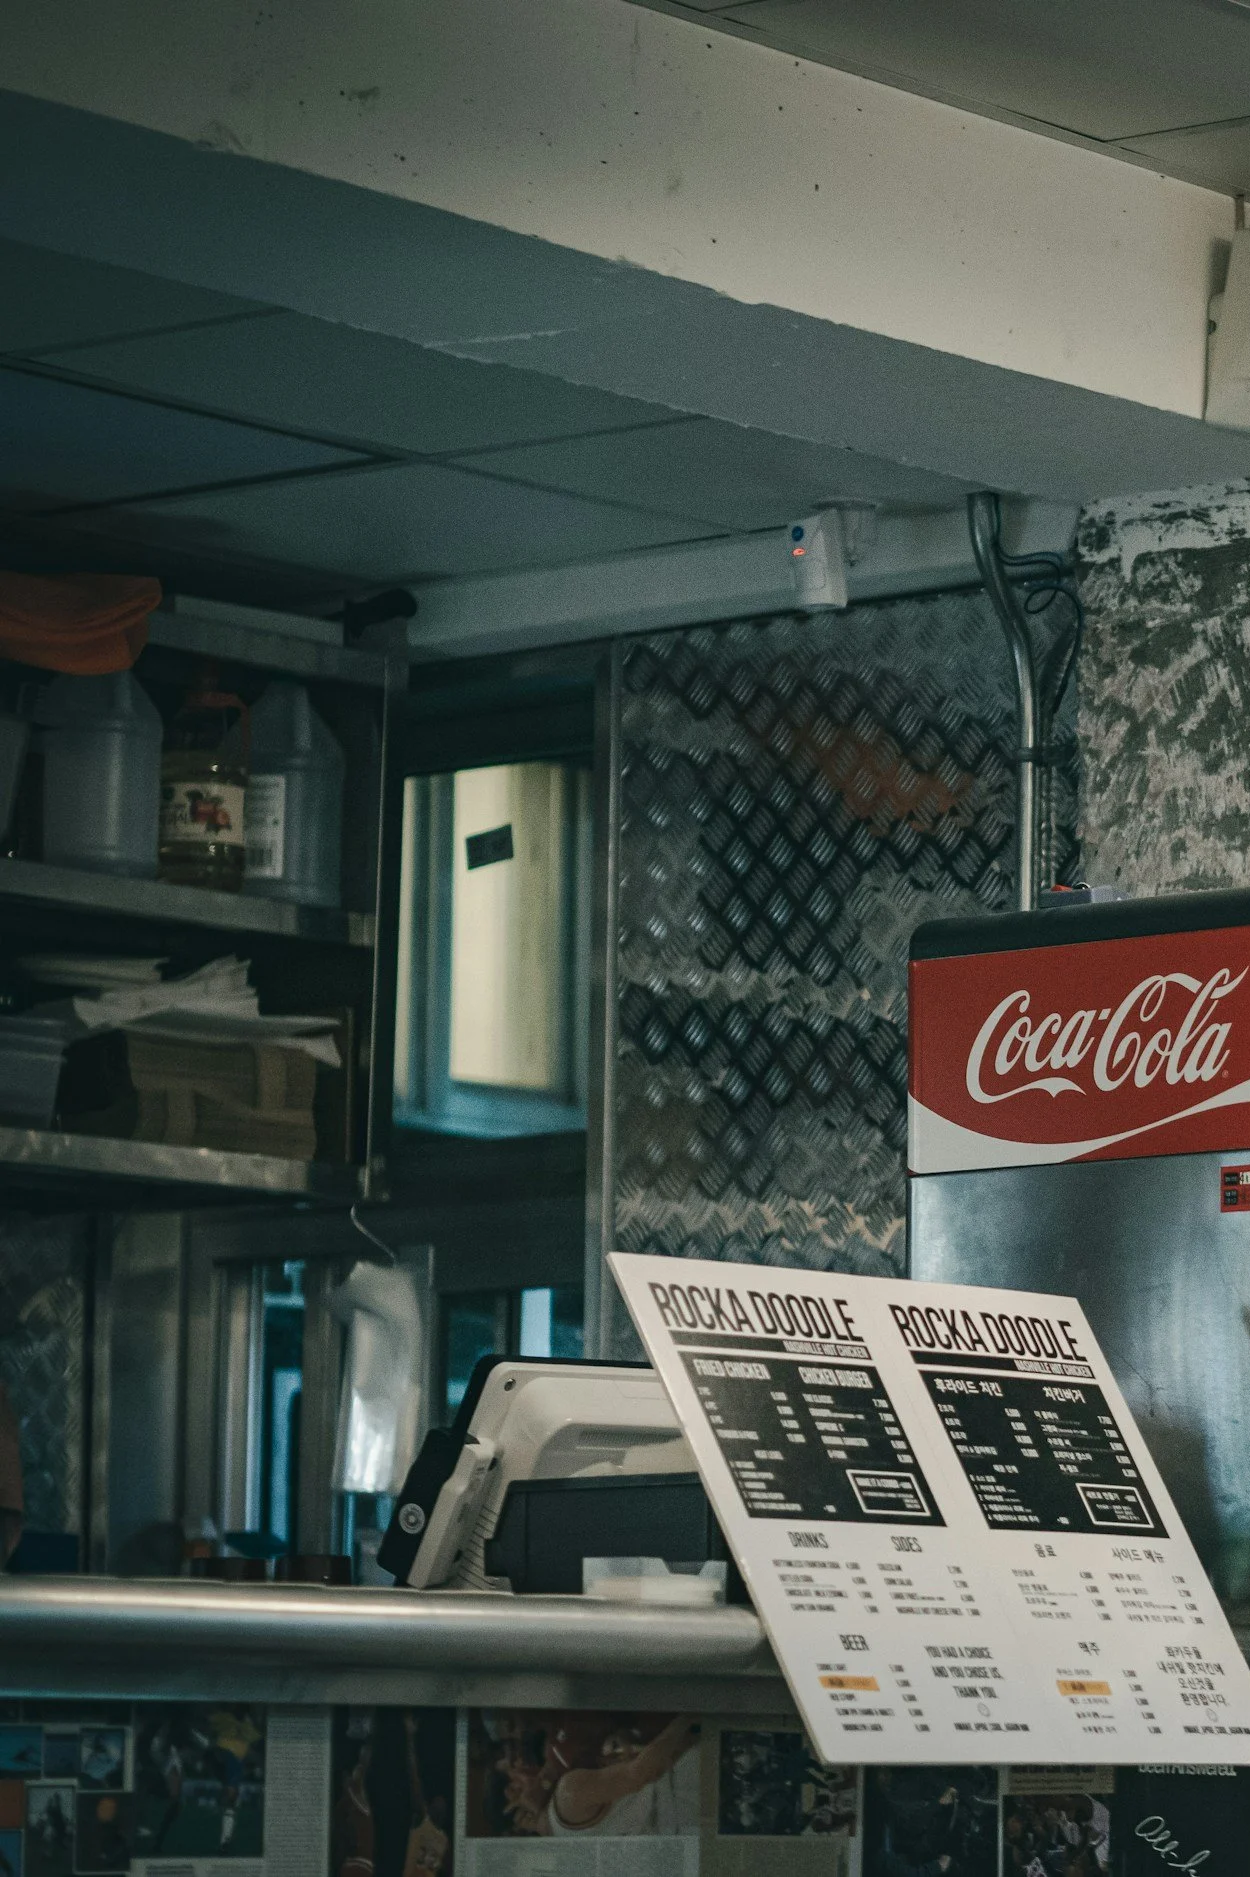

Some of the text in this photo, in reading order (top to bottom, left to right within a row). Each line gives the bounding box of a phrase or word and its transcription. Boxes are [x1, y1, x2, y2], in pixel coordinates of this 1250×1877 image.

[966, 965, 1250, 1104] Coca-Cola
[648, 1282, 864, 1342] ROCKA DOODLE
[888, 1304, 1088, 1362] ROCKA DOODLE
[693, 1359, 771, 1380] FRIED CHICKEN
[798, 1367, 873, 1389] CHICKEN BURGER
[933, 1378, 1003, 1397] 후라이드 치킨
[1042, 1386, 1086, 1404] 치킨버거
[788, 1532, 829, 1549] DRINKS
[891, 1536, 923, 1552] SIDES
[1033, 1544, 1057, 1558] 음료
[1112, 1547, 1143, 1561] 사이드
[839, 1635, 870, 1651] BEER
[1077, 1642, 1100, 1656] 맥주
[924, 1646, 994, 1659] YOU HAD A CHOICE
[932, 1666, 948, 1678] AND
[949, 1666, 964, 1679] YOU
[964, 1666, 990, 1679] CHOSE
[953, 1686, 979, 1698] THANK
